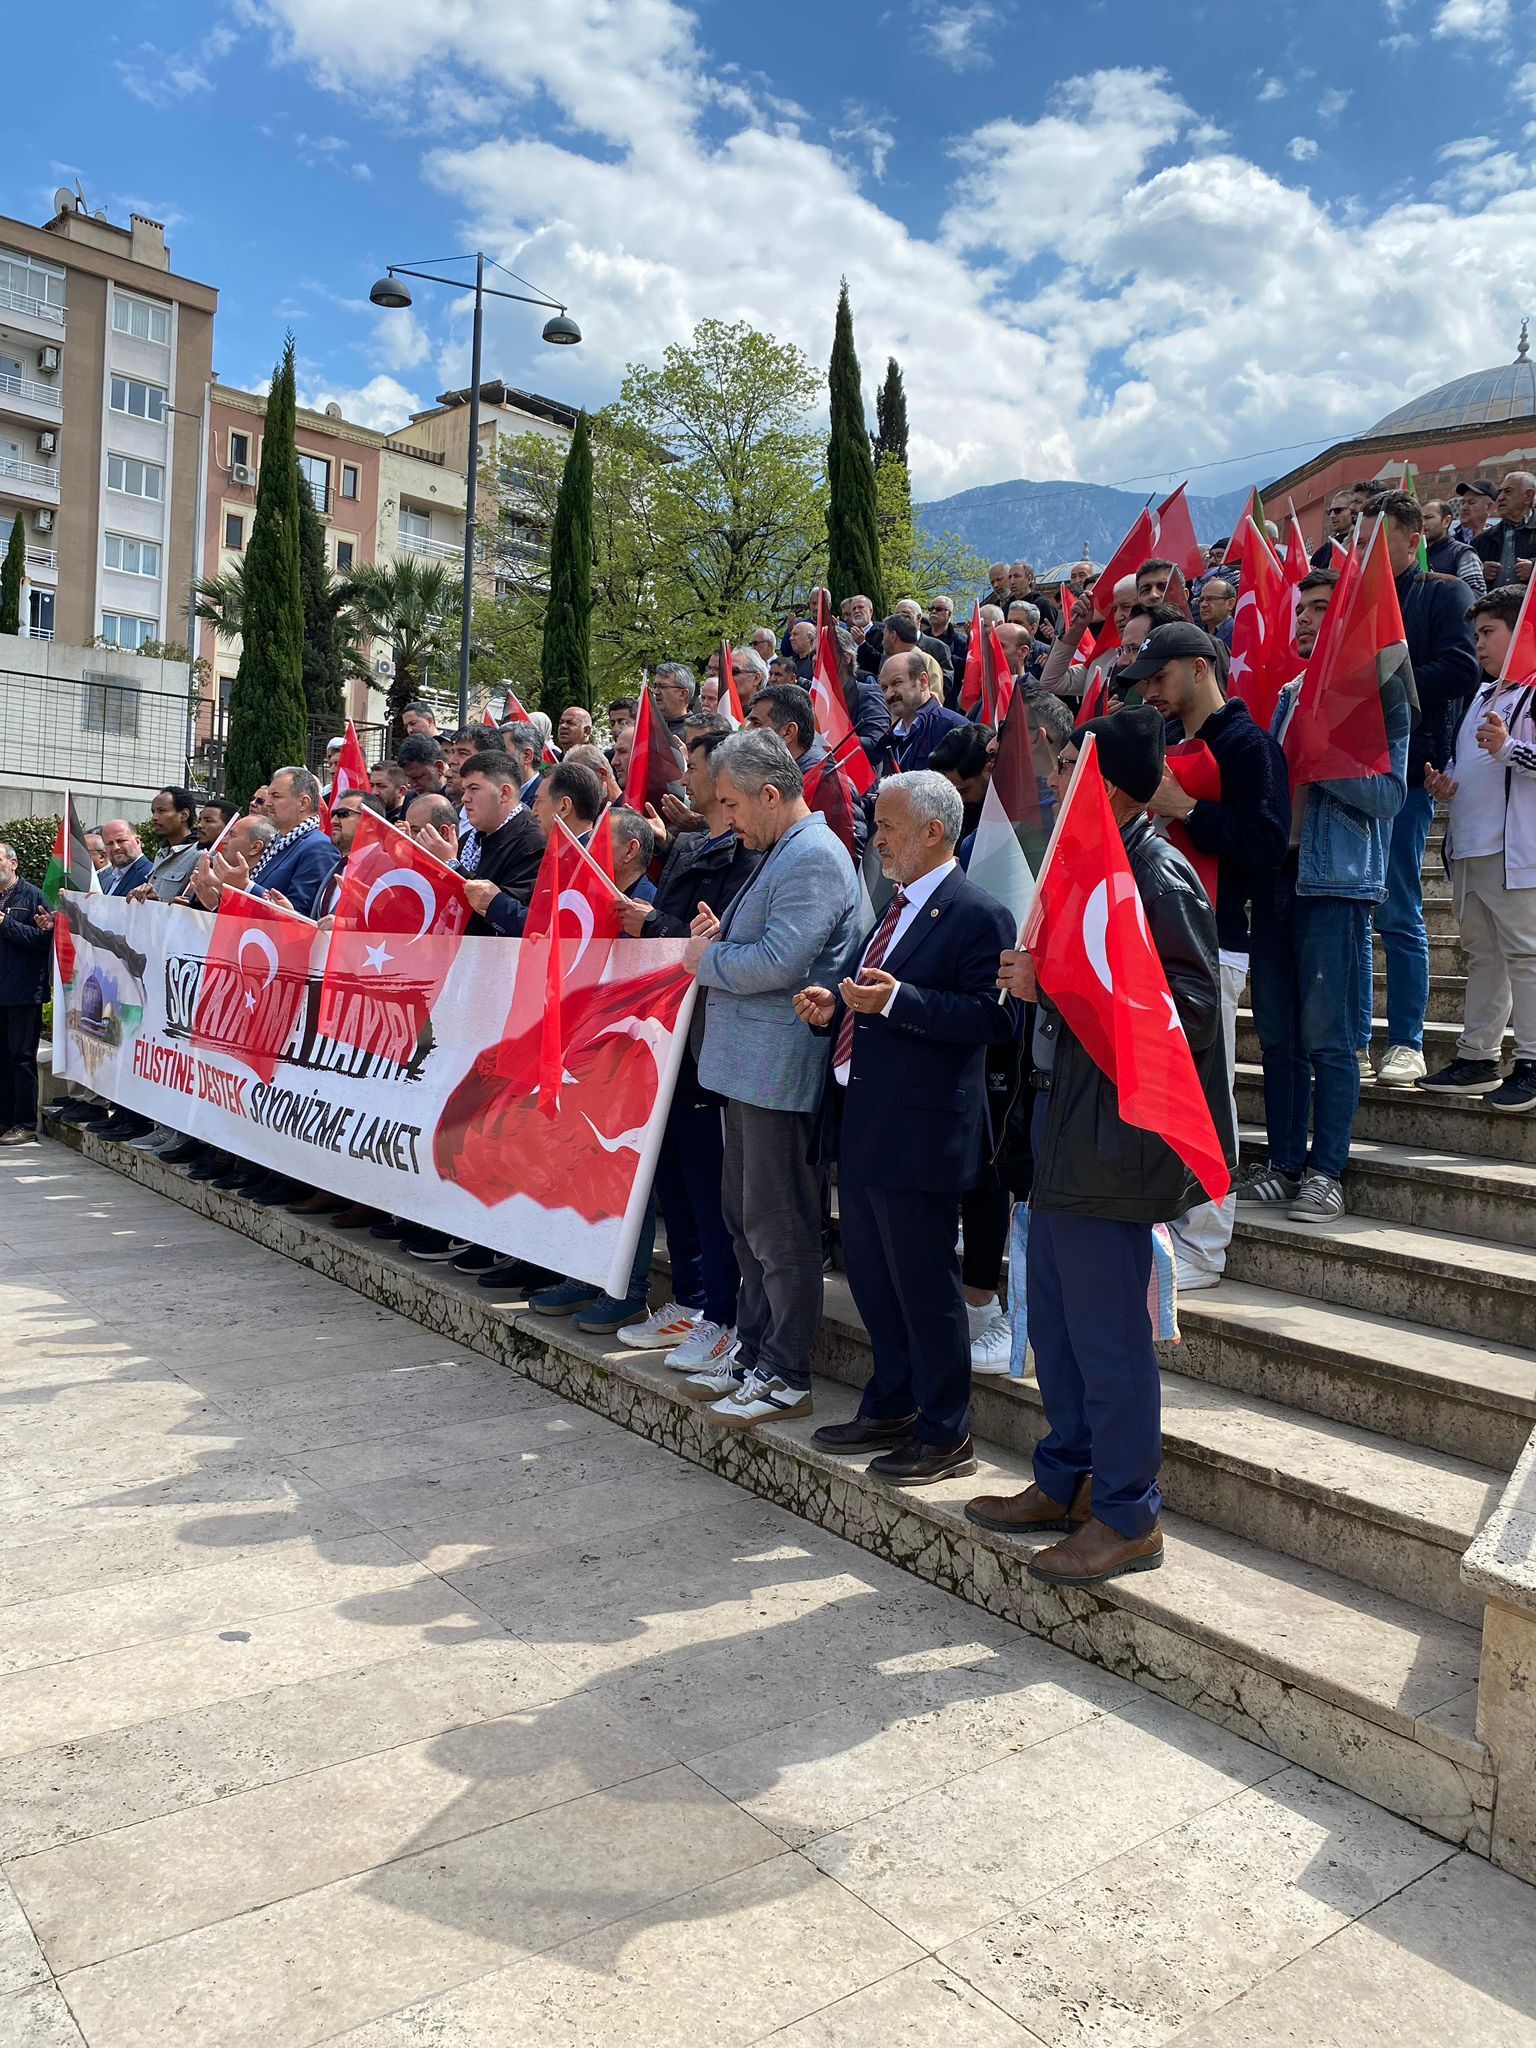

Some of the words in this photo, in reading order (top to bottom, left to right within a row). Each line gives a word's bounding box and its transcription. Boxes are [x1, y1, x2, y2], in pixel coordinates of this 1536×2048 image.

[168, 957, 310, 1061] SOYKIRIMA
[308, 988, 418, 1081] HAYIR!
[133, 1033, 195, 1096] FİLİSTİNE
[197, 1059, 248, 1119] DESTEK
[250, 1077, 355, 1153] SİYONİZME
[348, 1112, 422, 1175] LANET
[710, 1331, 730, 1359] TERREX
